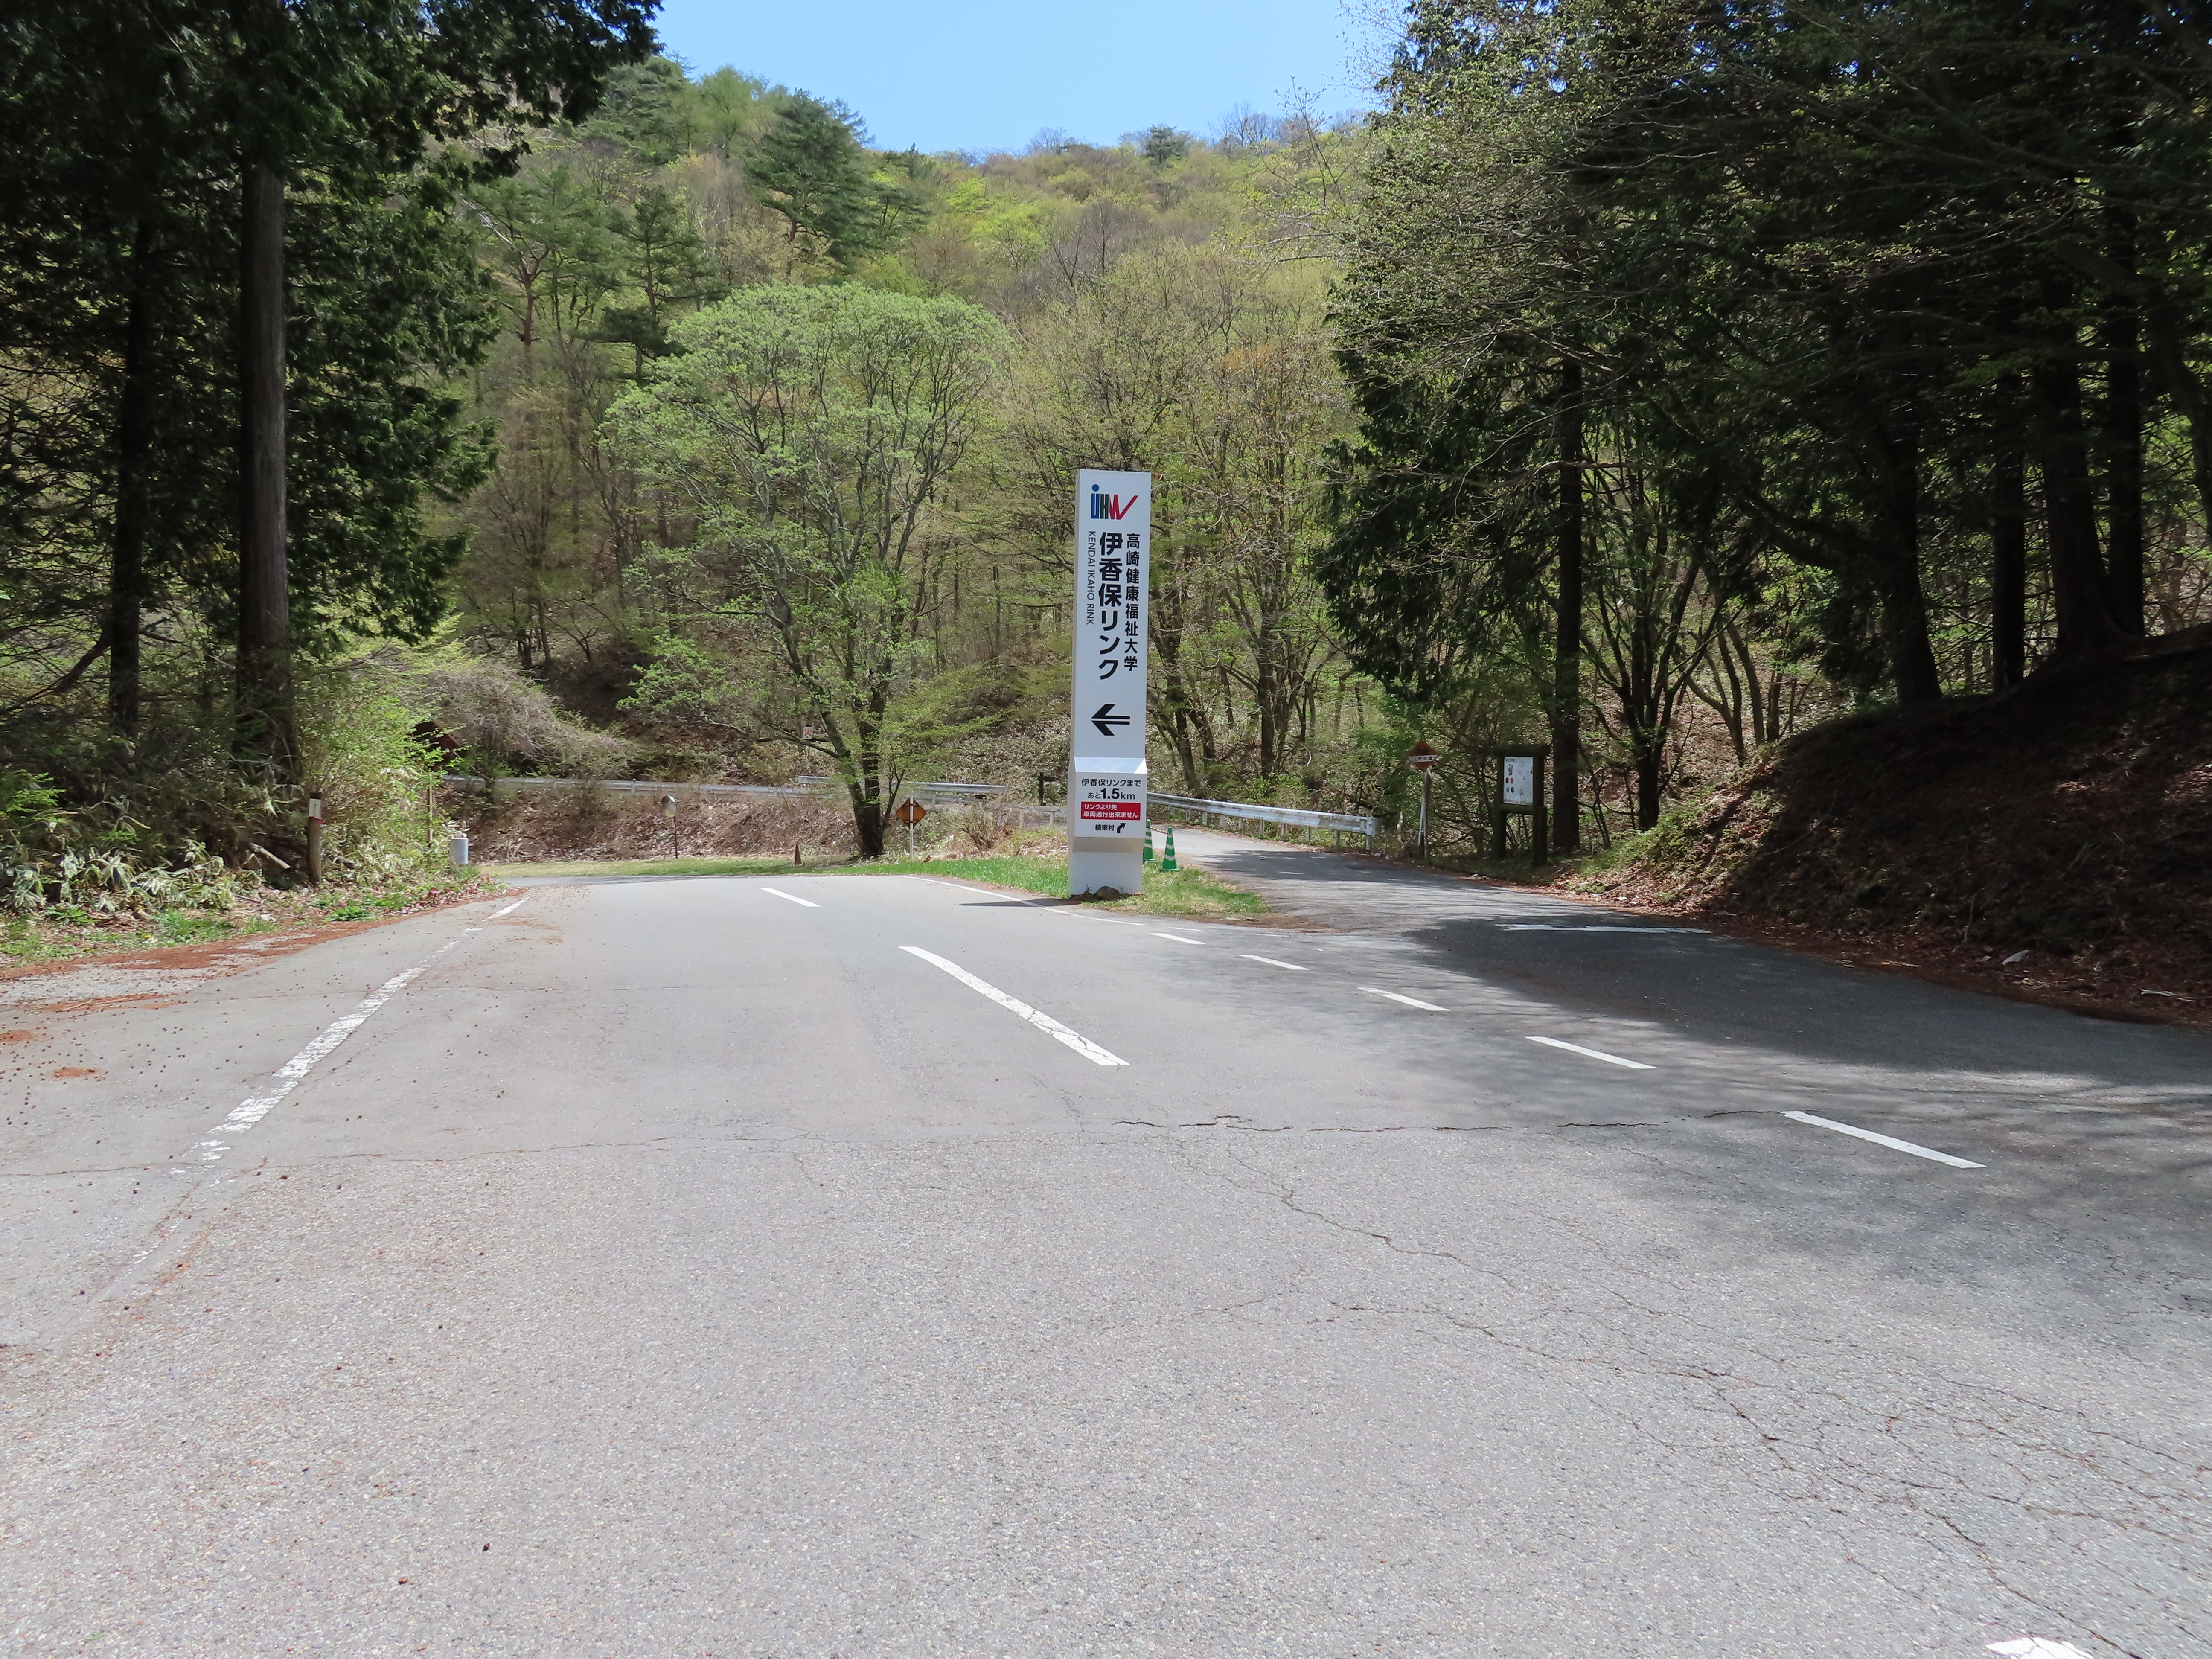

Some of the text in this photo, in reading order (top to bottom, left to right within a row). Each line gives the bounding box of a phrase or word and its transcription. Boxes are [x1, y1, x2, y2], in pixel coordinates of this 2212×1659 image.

[1087, 570, 1095, 600] IKAHO
[1086, 604, 1094, 625] RINK
[1098, 532, 1123, 680] 伊香保リンク
[1124, 533, 1140, 671] 高崎健康福祉大学
[1082, 778, 1141, 787] 伊香保リンクまで
